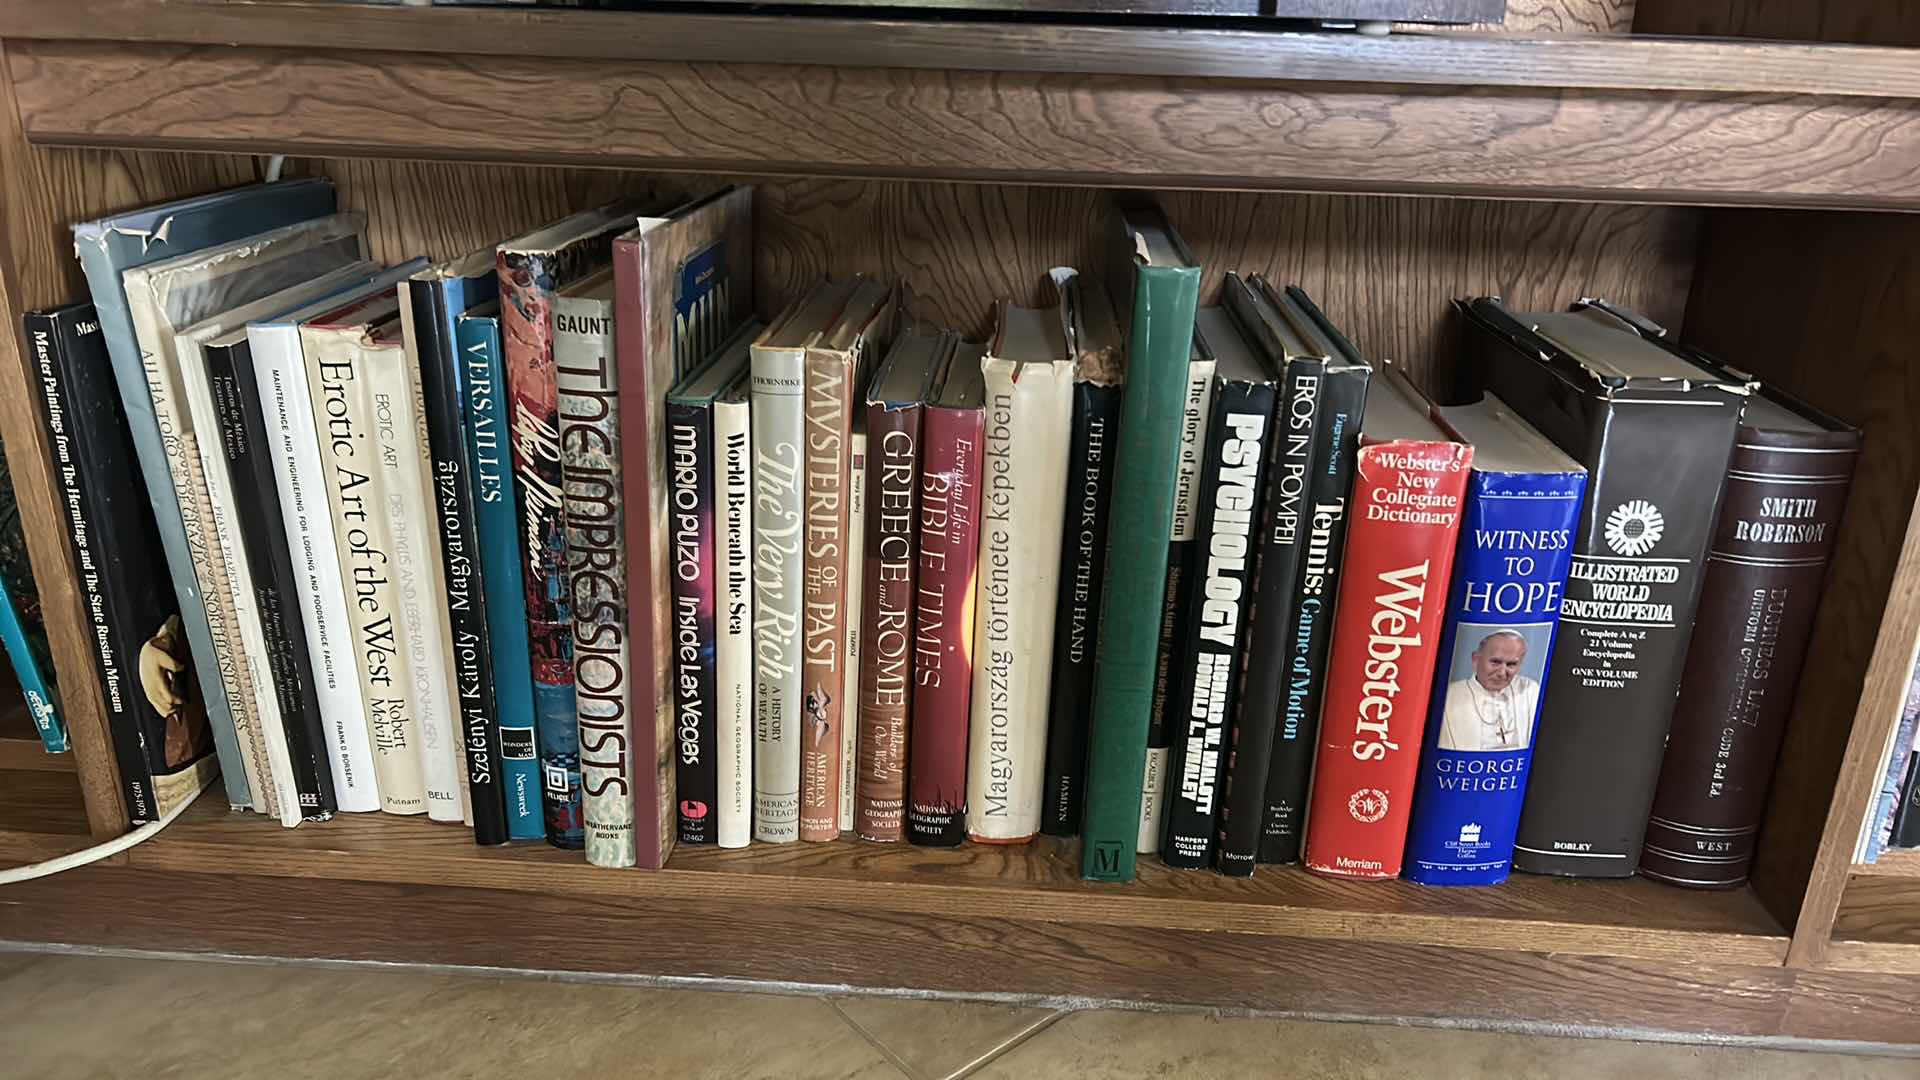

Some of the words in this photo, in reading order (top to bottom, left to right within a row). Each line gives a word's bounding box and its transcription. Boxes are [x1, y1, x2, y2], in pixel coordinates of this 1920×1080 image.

[557, 314, 611, 335] GAUNT
[33, 331, 51, 377] Master
[752, 376, 800, 386] THORNDIKE
[1192, 378, 1206, 405] The
[44, 376, 65, 432] Paintings
[272, 369, 289, 431] MAINTENANCE
[318, 357, 364, 457] Erotic
[372, 392, 396, 442] EROTIC
[1290, 375, 1317, 429] EROS
[221, 418, 232, 429] of
[467, 342, 501, 504] VERSAILLES
[1087, 417, 1104, 462] THE
[1182, 409, 1203, 442] glory
[55, 433, 70, 463] from
[283, 434, 294, 453] AND
[381, 443, 399, 470] ART
[986, 394, 1015, 527] képekben
[1181, 450, 1195, 464] of
[1287, 436, 1309, 457] IN
[61, 464, 76, 485] The
[727, 433, 746, 490] World
[758, 442, 799, 515] The
[806, 370, 842, 559] MYSTERIES
[953, 438, 972, 504] Everyday
[1380, 452, 1460, 472] Webster's
[286, 456, 305, 512] ENGINEERING
[337, 465, 370, 519] Art
[1081, 467, 1100, 525] BOOK
[1397, 472, 1439, 488] New
[879, 431, 913, 582] GREECE
[1174, 468, 1194, 536] Jerusalem
[1273, 464, 1304, 545] POMPEII
[1372, 488, 1457, 509] Collegiate
[1759, 497, 1817, 518] SMITH
[65, 486, 87, 546] Hermitage
[299, 516, 308, 534] FOR
[728, 493, 746, 567] Beneath
[920, 472, 949, 572] BIBLE
[952, 507, 968, 531] Life
[1200, 414, 1265, 647] PSYCHOLOGY
[1367, 505, 1458, 528] Dictionary
[1734, 521, 1826, 544] ROBERSON
[348, 529, 389, 564] of
[438, 460, 471, 611] Magyarország
[951, 533, 965, 545] in
[1079, 531, 1094, 558] OF
[1303, 497, 1344, 595] Tennis:
[1475, 530, 1570, 550] WITNESS
[80, 547, 90, 571] and
[302, 535, 315, 572] LODGING
[755, 511, 800, 599] Very
[1504, 557, 1535, 575] TO
[84, 572, 97, 595] The
[310, 575, 318, 591] AND
[353, 566, 387, 613] the
[399, 569, 418, 600] AND
[728, 568, 746, 597] the
[808, 566, 821, 596] THE
[822, 566, 837, 588] OF
[984, 531, 1009, 642] története
[1075, 560, 1091, 600] THE
[1570, 562, 1679, 583] ILLUSTRATED
[877, 584, 893, 607] and
[1464, 581, 1561, 613] HOPE
[1592, 583, 1650, 601] WORLD
[89, 594, 103, 626] State
[313, 595, 328, 646] FOODSERVICE
[728, 599, 746, 636] Sea
[1297, 599, 1321, 654] Game
[1560, 599, 1672, 621] ENCYCLOPEDIA
[1742, 587, 1767, 643] UNIFORM
[96, 625, 114, 666] Russian
[755, 596, 799, 680] Rich
[807, 602, 836, 672] PAST
[915, 584, 944, 688] TIMES
[1070, 607, 1087, 663] HAND
[1580, 629, 1618, 638] Complete
[1603, 641, 1632, 649] Volume
[201, 589, 237, 687] NORTHLAND
[226, 689, 249, 733] PRESS
[362, 614, 397, 688] West
[455, 631, 480, 699] Károly
[875, 607, 907, 706] ROME
[1293, 656, 1312, 674] of
[1352, 560, 1430, 761] Webster's
[1583, 649, 1635, 659] Encyclopedia
[324, 650, 336, 689] FACILITIES
[680, 665, 702, 699] Las
[1192, 652, 1214, 718] DONALD
[1572, 668, 1594, 677] ONE
[1596, 670, 1638, 679] VOLUME
[1583, 679, 1624, 688] EDITION
[103, 666, 123, 713] Museum
[759, 683, 768, 698] OF
[772, 687, 780, 696] A
[1208, 654, 1231, 724] RICHARD
[388, 698, 407, 748] Robert
[758, 699, 768, 743] WEALTH
[771, 699, 784, 743] HISTORY
[1283, 676, 1309, 740] Motion
[336, 721, 345, 743] FRANK
[371, 699, 389, 756] Melville
[678, 701, 703, 765] Vegas
[985, 651, 1013, 817] Magyarország
[1189, 720, 1205, 735] L.
[1204, 727, 1221, 748] W.
[1716, 727, 1735, 759] CODE
[463, 707, 491, 784] Szelényi
[874, 745, 888, 780] World
[806, 752, 816, 807] HERITAGE
[817, 752, 827, 807] AMERICAN
[1182, 737, 1203, 801] WHALEY
[1436, 757, 1525, 774] GEORGE
[1712, 761, 1727, 781] 3rd
[132, 781, 147, 816] 1975-1976
[428, 790, 454, 800] BELL
[1059, 775, 1070, 822] HAMLYN
[1196, 751, 1218, 815] MALOTT
[1437, 775, 1518, 791] WEIGEL
[1707, 781, 1723, 799] Ed.
[386, 796, 421, 805] Putnam
[914, 804, 946, 814] NATIONAL
[596, 832, 619, 840] BOOKS
[683, 834, 705, 842] 12462
[759, 826, 794, 835] CROWN
[914, 824, 943, 835] SOCIETY
[1175, 835, 1208, 844] HARPER'S
[1175, 842, 1206, 850] COLLEGE
[1696, 841, 1732, 851] WEST
[1226, 852, 1254, 861] Morrow
[1336, 857, 1382, 870] Merriam
